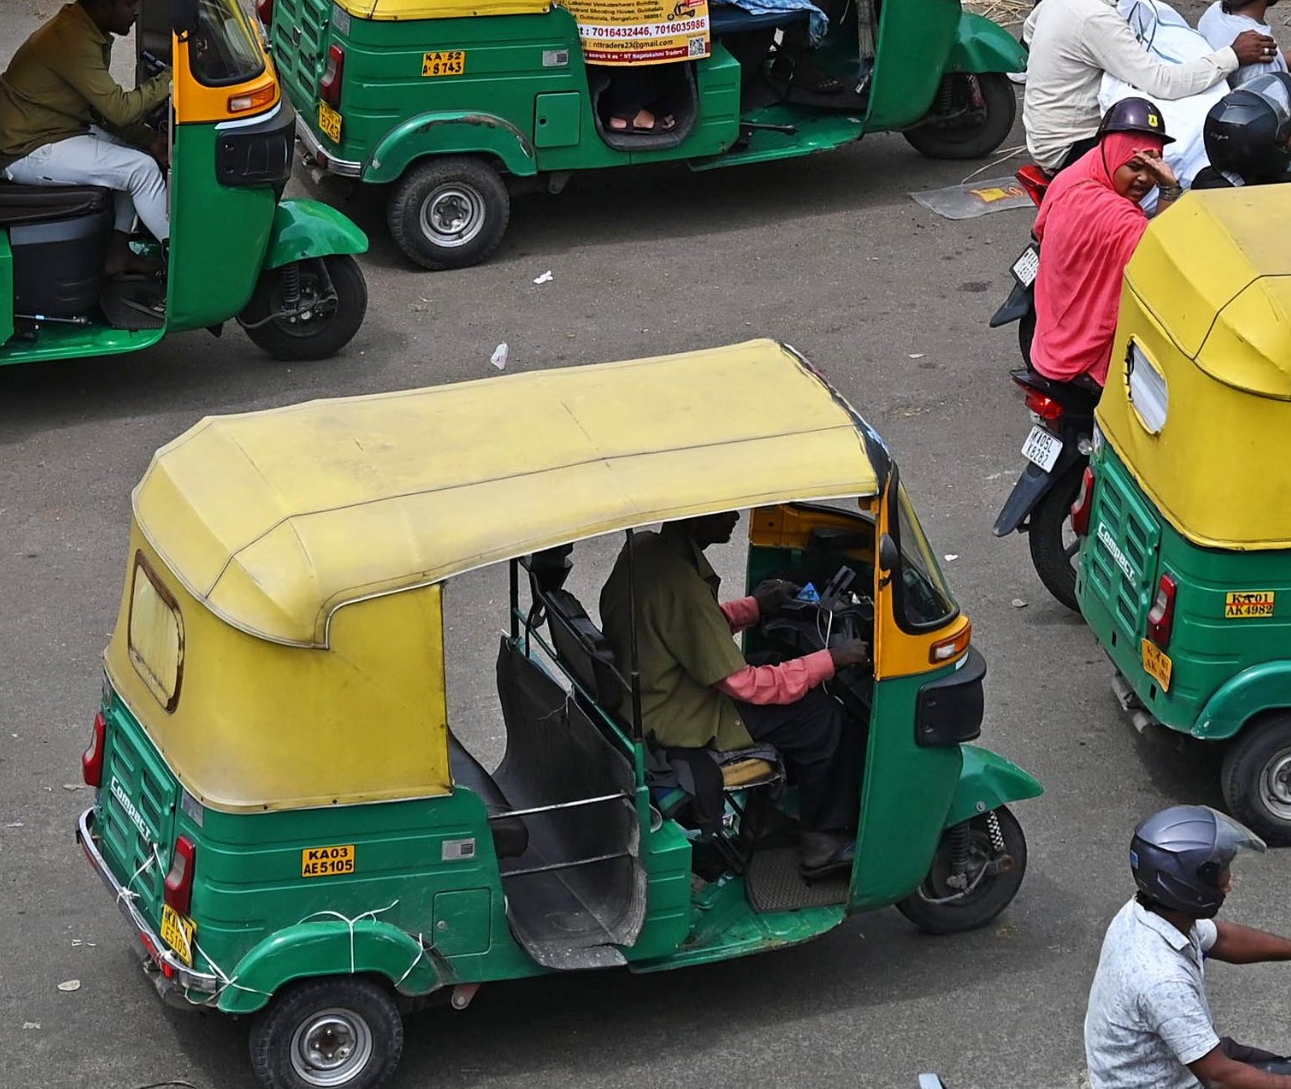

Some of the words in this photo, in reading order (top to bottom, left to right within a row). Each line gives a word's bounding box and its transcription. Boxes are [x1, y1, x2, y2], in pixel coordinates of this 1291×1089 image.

[593, 25, 653, 37] 7016432446,
[654, 18, 707, 34] 7016035986
[1097, 521, 1137, 583] Compact
[110, 775, 152, 843] Compact
[308, 847, 348, 861] KA03
